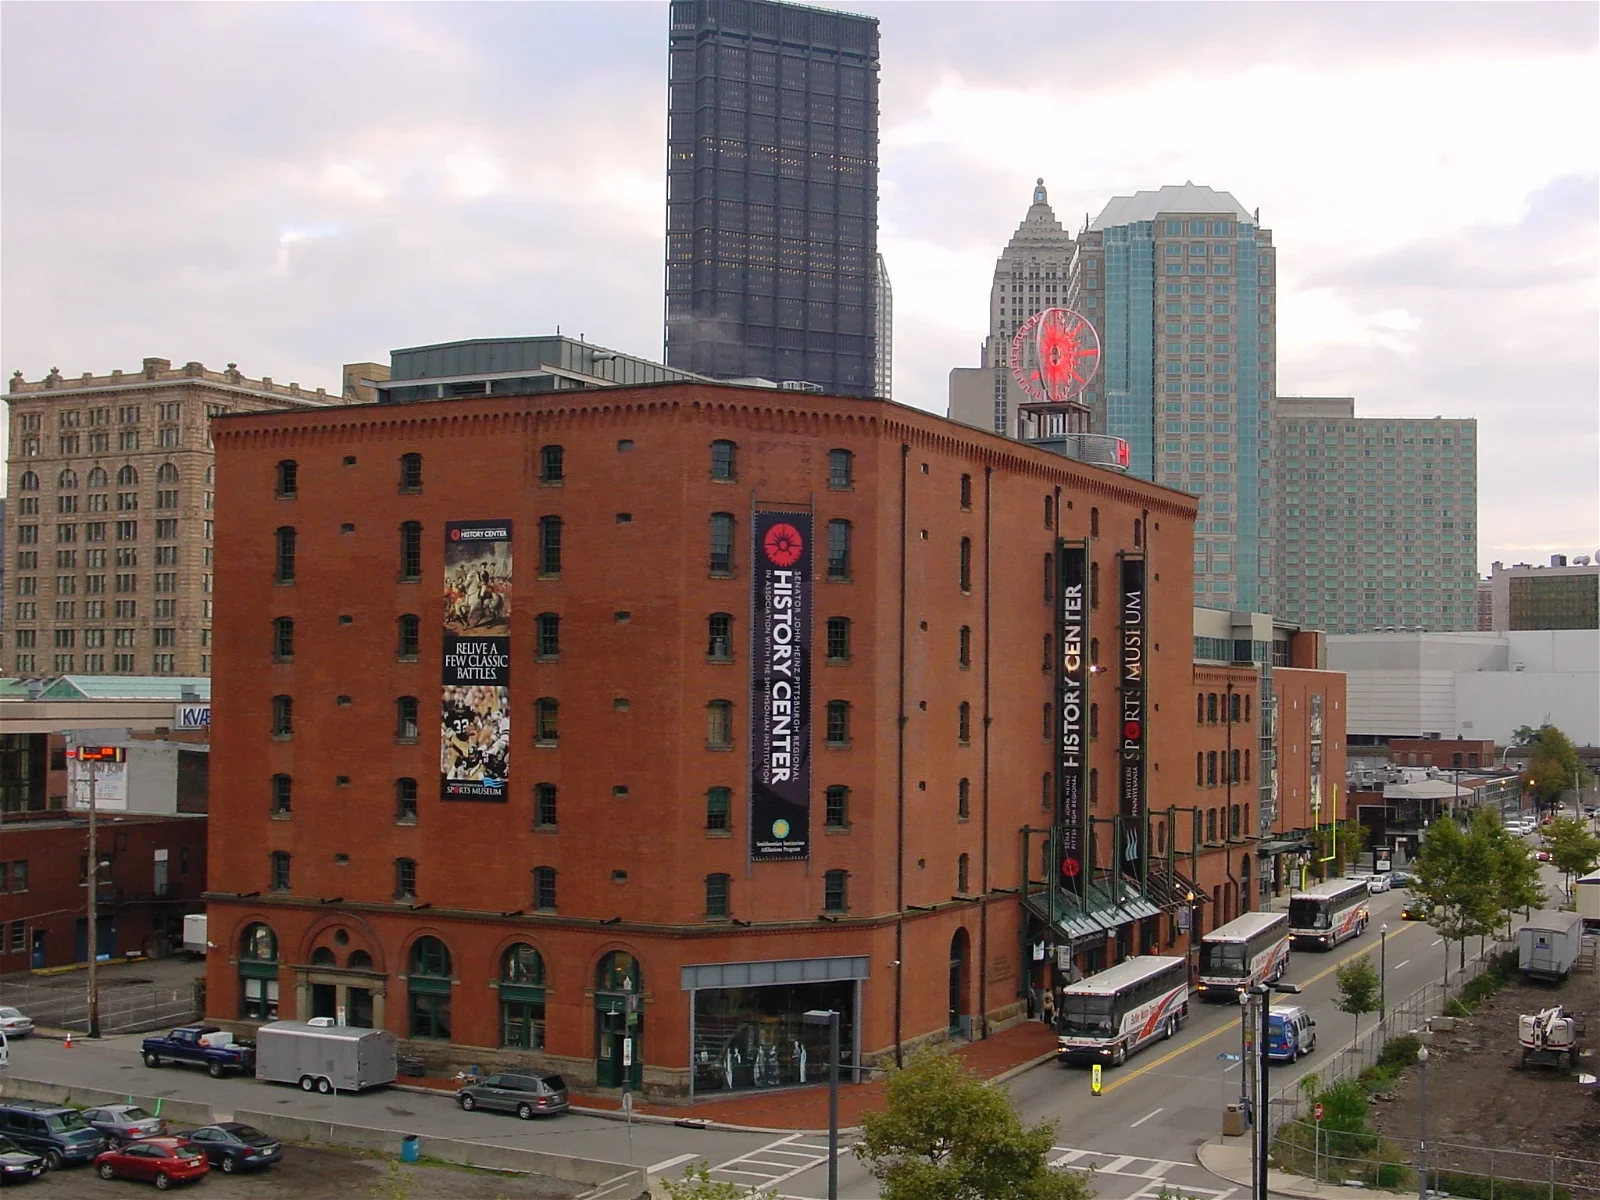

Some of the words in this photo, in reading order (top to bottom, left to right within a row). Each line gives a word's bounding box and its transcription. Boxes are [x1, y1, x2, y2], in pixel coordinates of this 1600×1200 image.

[765, 569, 771, 579] IN
[773, 570, 792, 677] HISTORY
[1064, 583, 1082, 675] CENTER
[445, 655, 467, 667] FEW
[468, 655, 509, 668] CLASSIC
[456, 642, 488, 655] RELIVE
[489, 642, 498, 655] A
[457, 667, 497, 679] BATTLES.
[763, 677, 771, 731] SMITHSONIAN
[1063, 676, 1080, 767] HISTORY
[771, 681, 792, 785] CENTER
[792, 735, 800, 782] REGIONAL
[447, 786, 471, 794] SPORTS
[472, 787, 502, 795] MUSEUM
